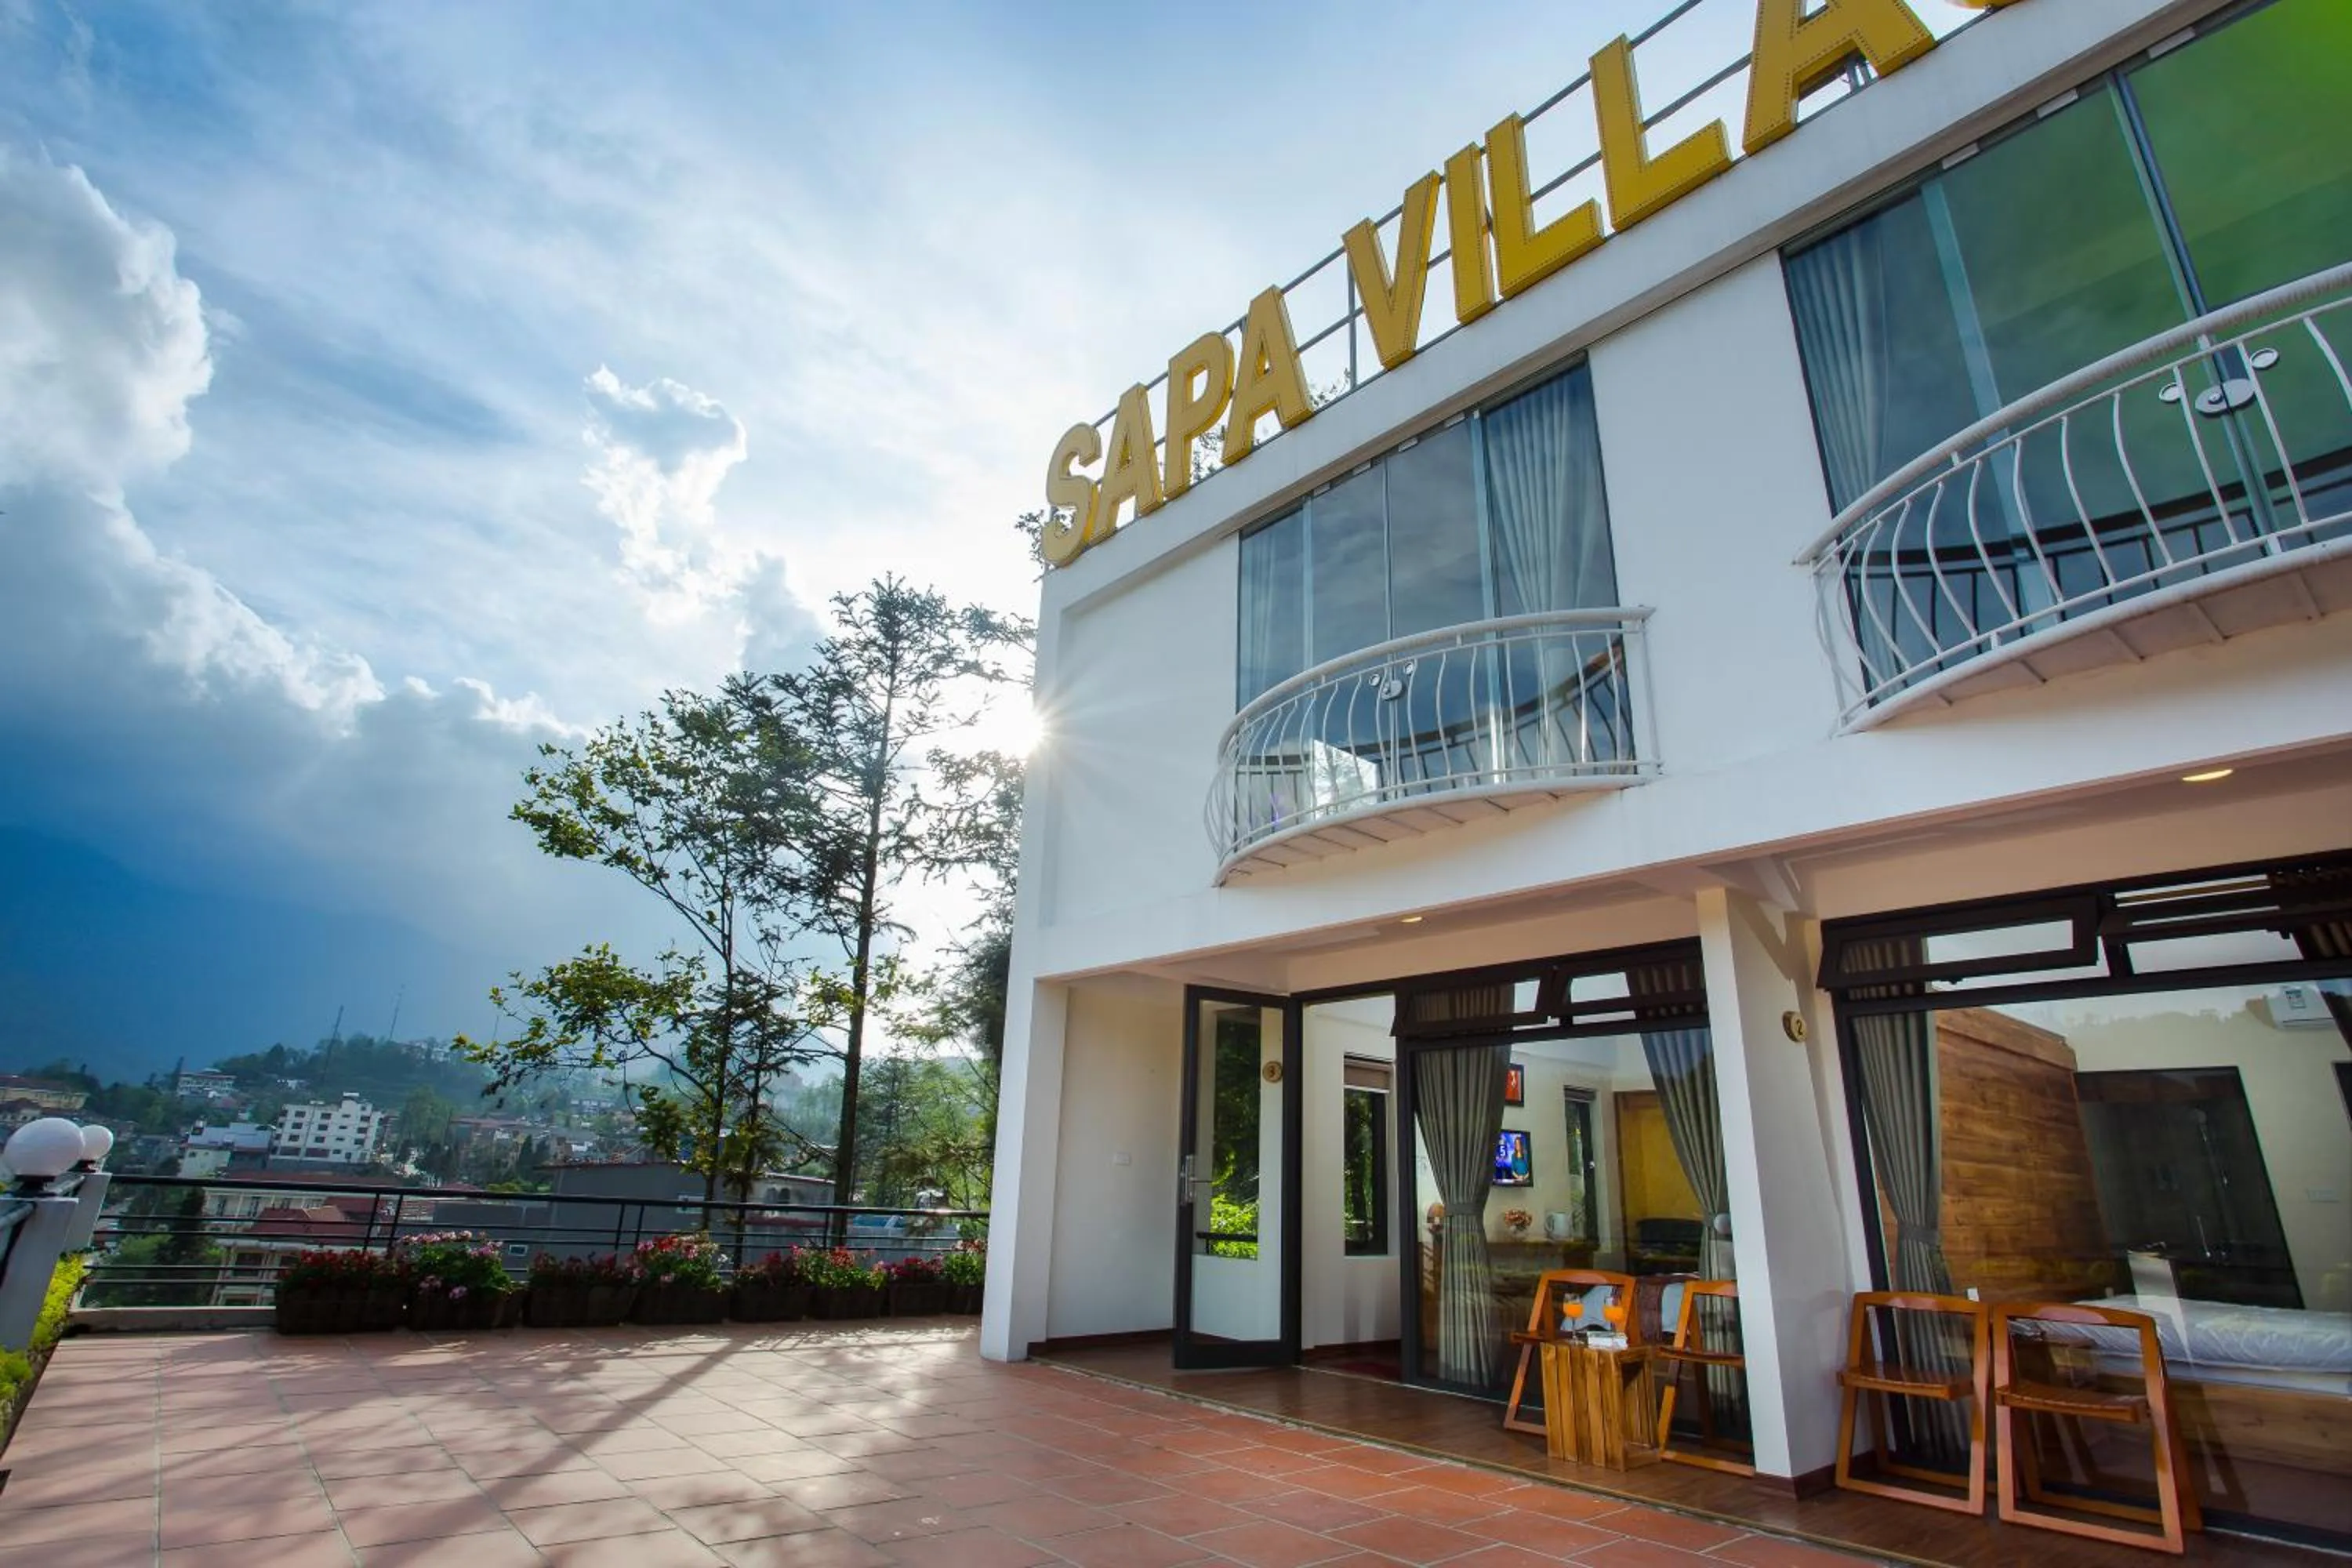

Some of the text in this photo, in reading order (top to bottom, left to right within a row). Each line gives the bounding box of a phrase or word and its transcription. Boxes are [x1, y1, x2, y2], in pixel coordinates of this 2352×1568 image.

[1041, 0, 2026, 567] SAPA VILLA
[1795, 1018, 1803, 1036] 2
[1500, 1145, 1506, 1156] 5
